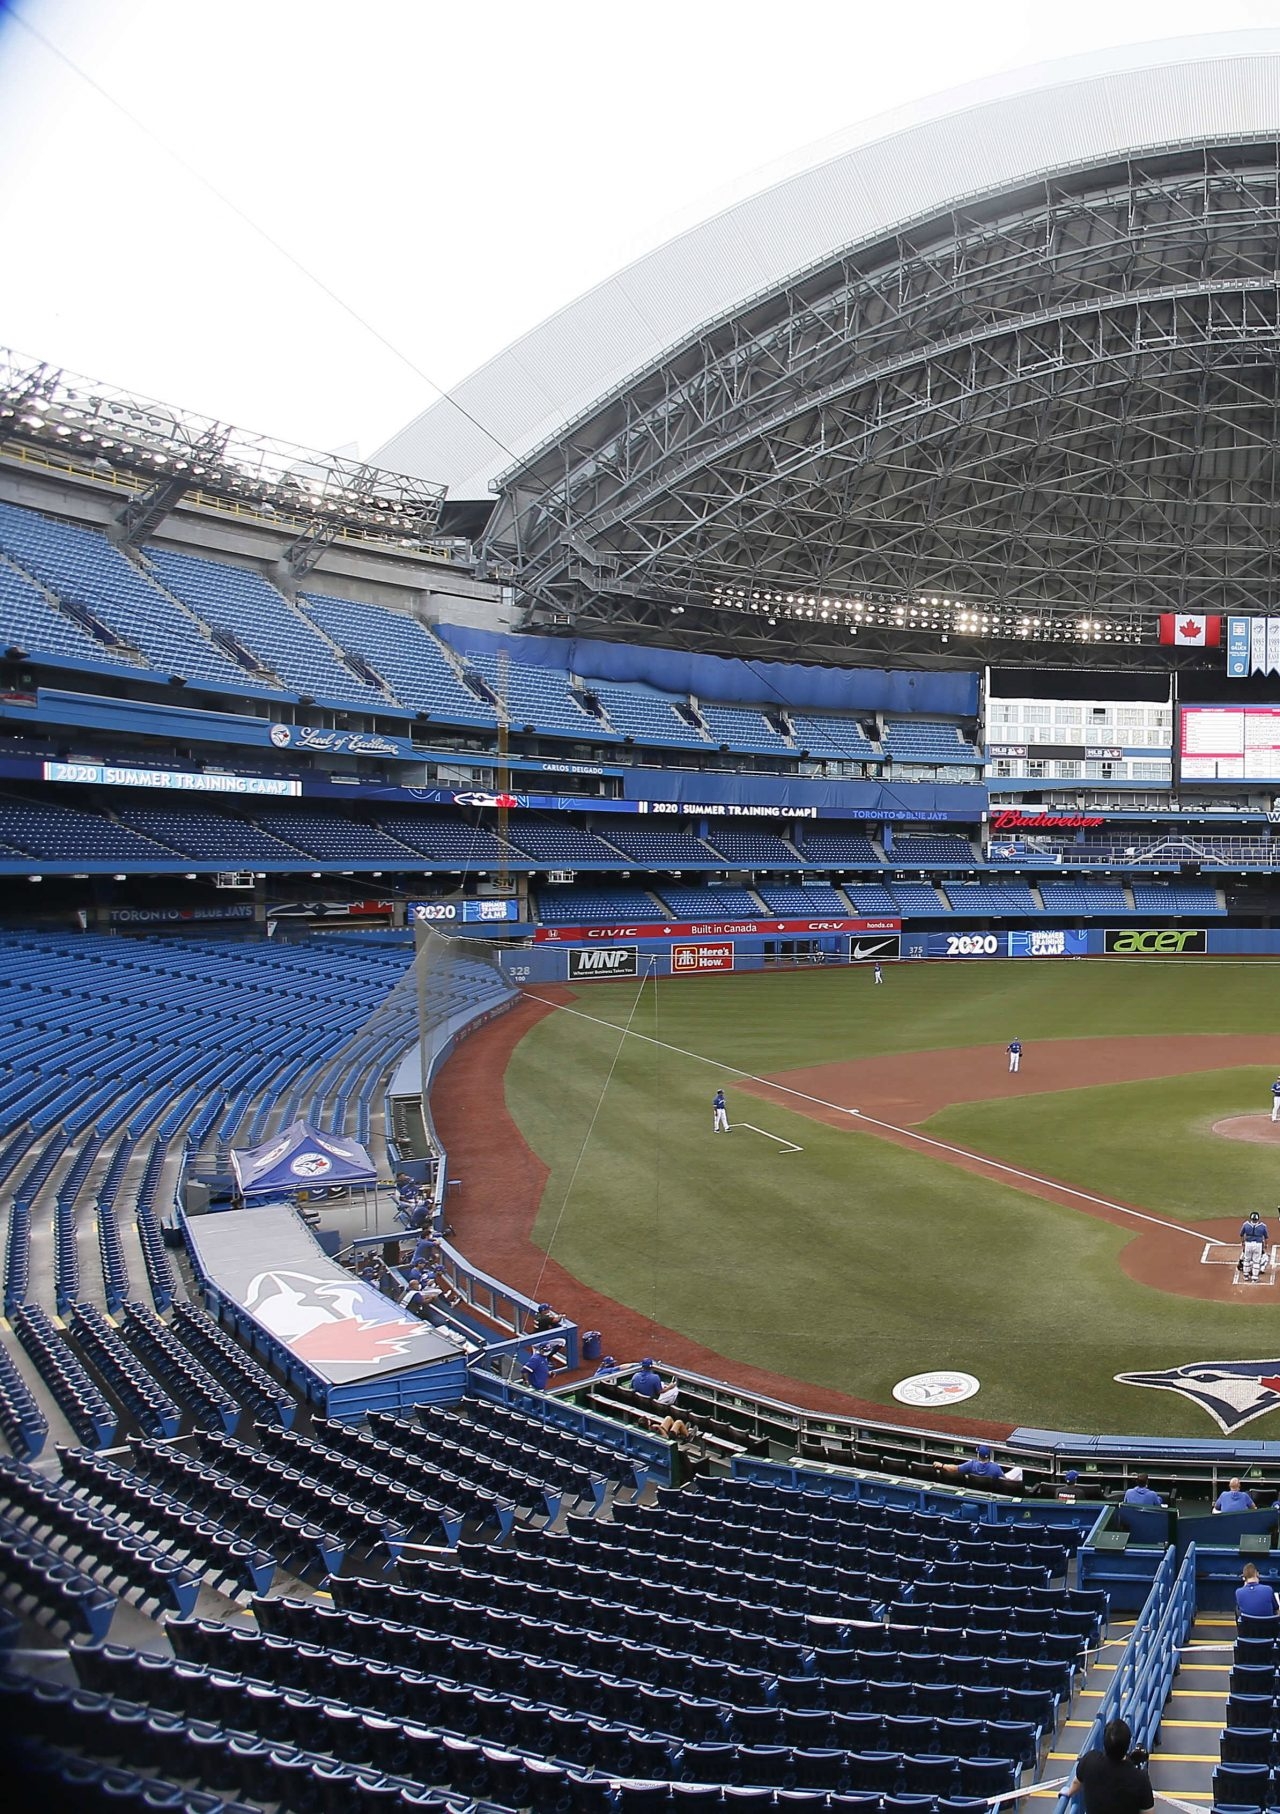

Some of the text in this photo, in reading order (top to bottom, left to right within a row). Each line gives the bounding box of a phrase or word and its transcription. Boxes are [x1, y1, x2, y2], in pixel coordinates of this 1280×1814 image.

[295, 727, 399, 755] Level of Excellence
[543, 763, 603, 775] CARLOS DELGADO
[57, 767, 287, 795] 2020 SUMMER TRAINING CAMP
[653, 803, 812, 818] 2020 SUMMER TRAINING CAMP
[852, 810, 895, 819] TORONTO
[927, 812, 948, 821] JAYS
[991, 810, 1104, 828] Budweiser
[112, 905, 253, 921] TORONTO BLUE JAYS
[416, 905, 456, 919] 2020
[481, 911, 507, 919] CAMP
[691, 923, 757, 935] Built in Canada
[808, 922, 844, 930] CR-V
[866, 920, 894, 929] honda.ca
[588, 928, 638, 937] CIVIC
[1032, 931, 1065, 940] SUMMER
[946, 935, 998, 954] 2020
[1113, 931, 1198, 952] acer
[698, 947, 730, 957] Here's
[909, 946, 924, 954] 375
[1031, 944, 1066, 955] CAMP
[578, 950, 629, 970] MNP
[699, 957, 723, 967] How.
[509, 966, 530, 976] 328
